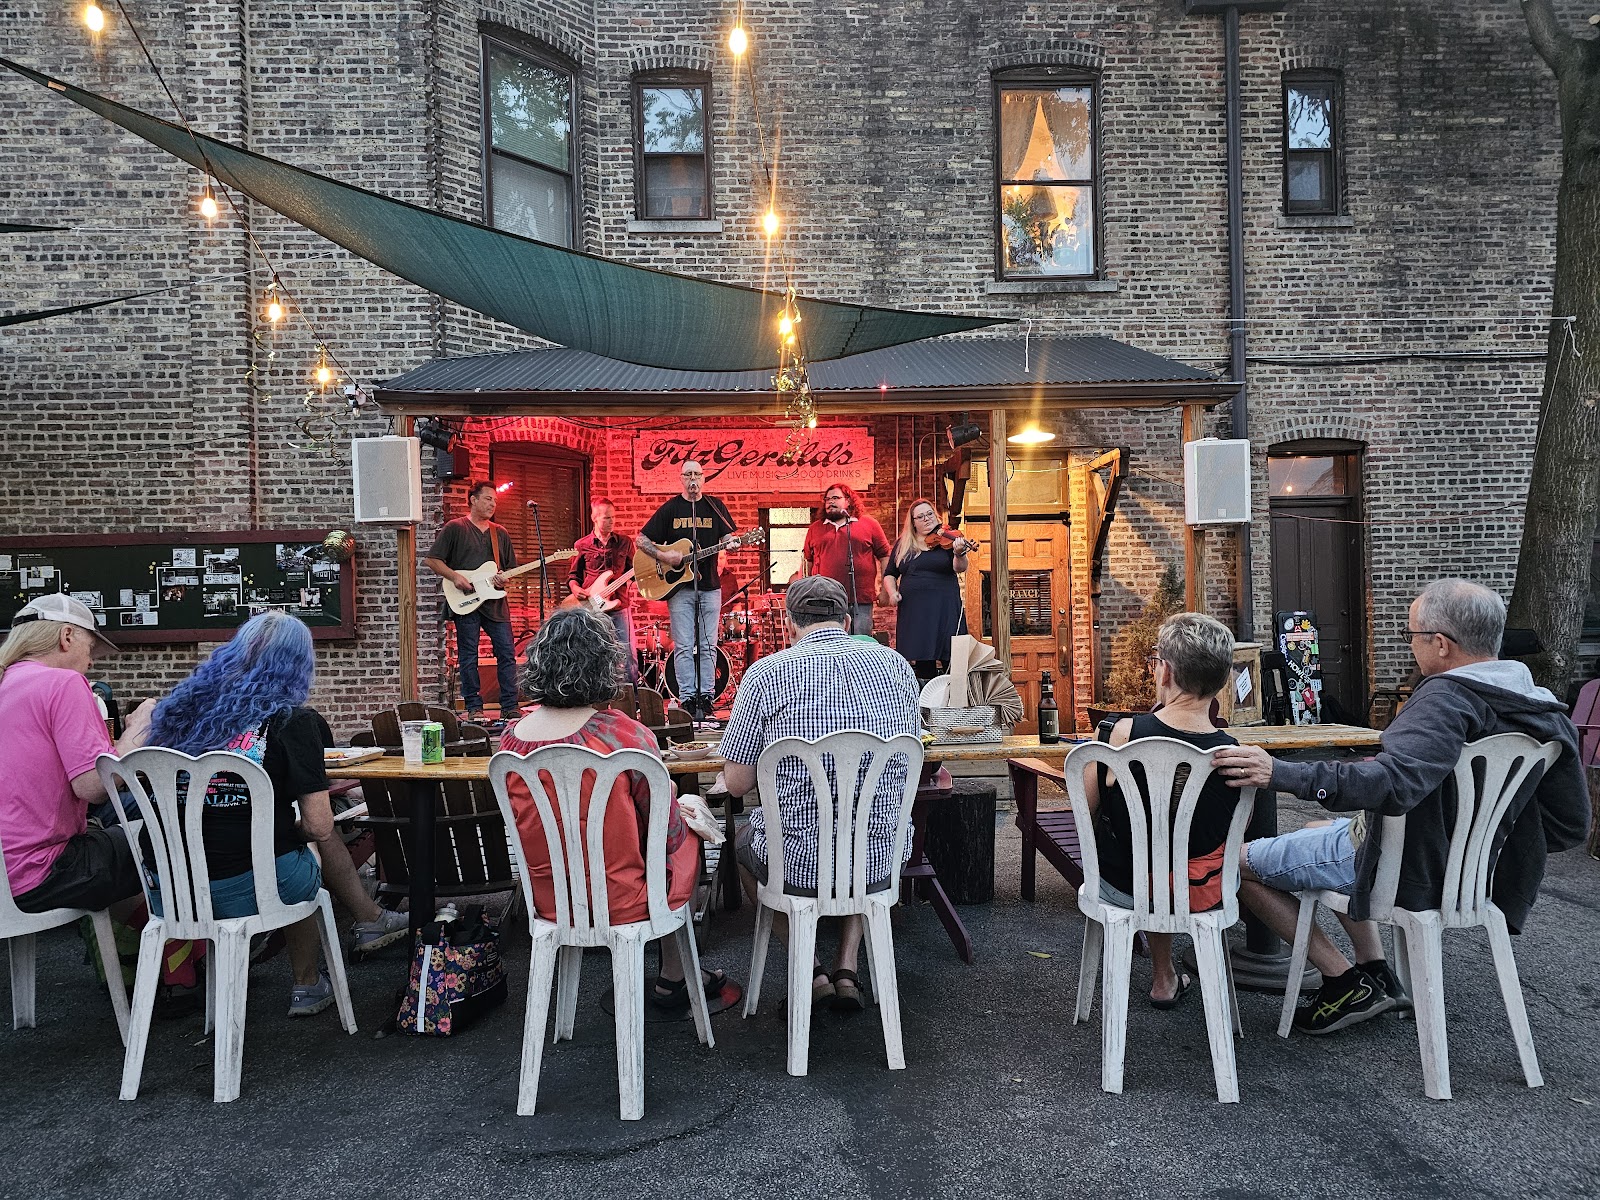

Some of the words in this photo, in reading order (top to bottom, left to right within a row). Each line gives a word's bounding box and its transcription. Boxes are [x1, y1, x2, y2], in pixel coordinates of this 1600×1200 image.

[641, 438, 868, 483] FitzGerald's
[727, 470, 747, 479] LIVE
[826, 469, 861, 479] DRINKS
[1009, 589, 1040, 598] RANCE
